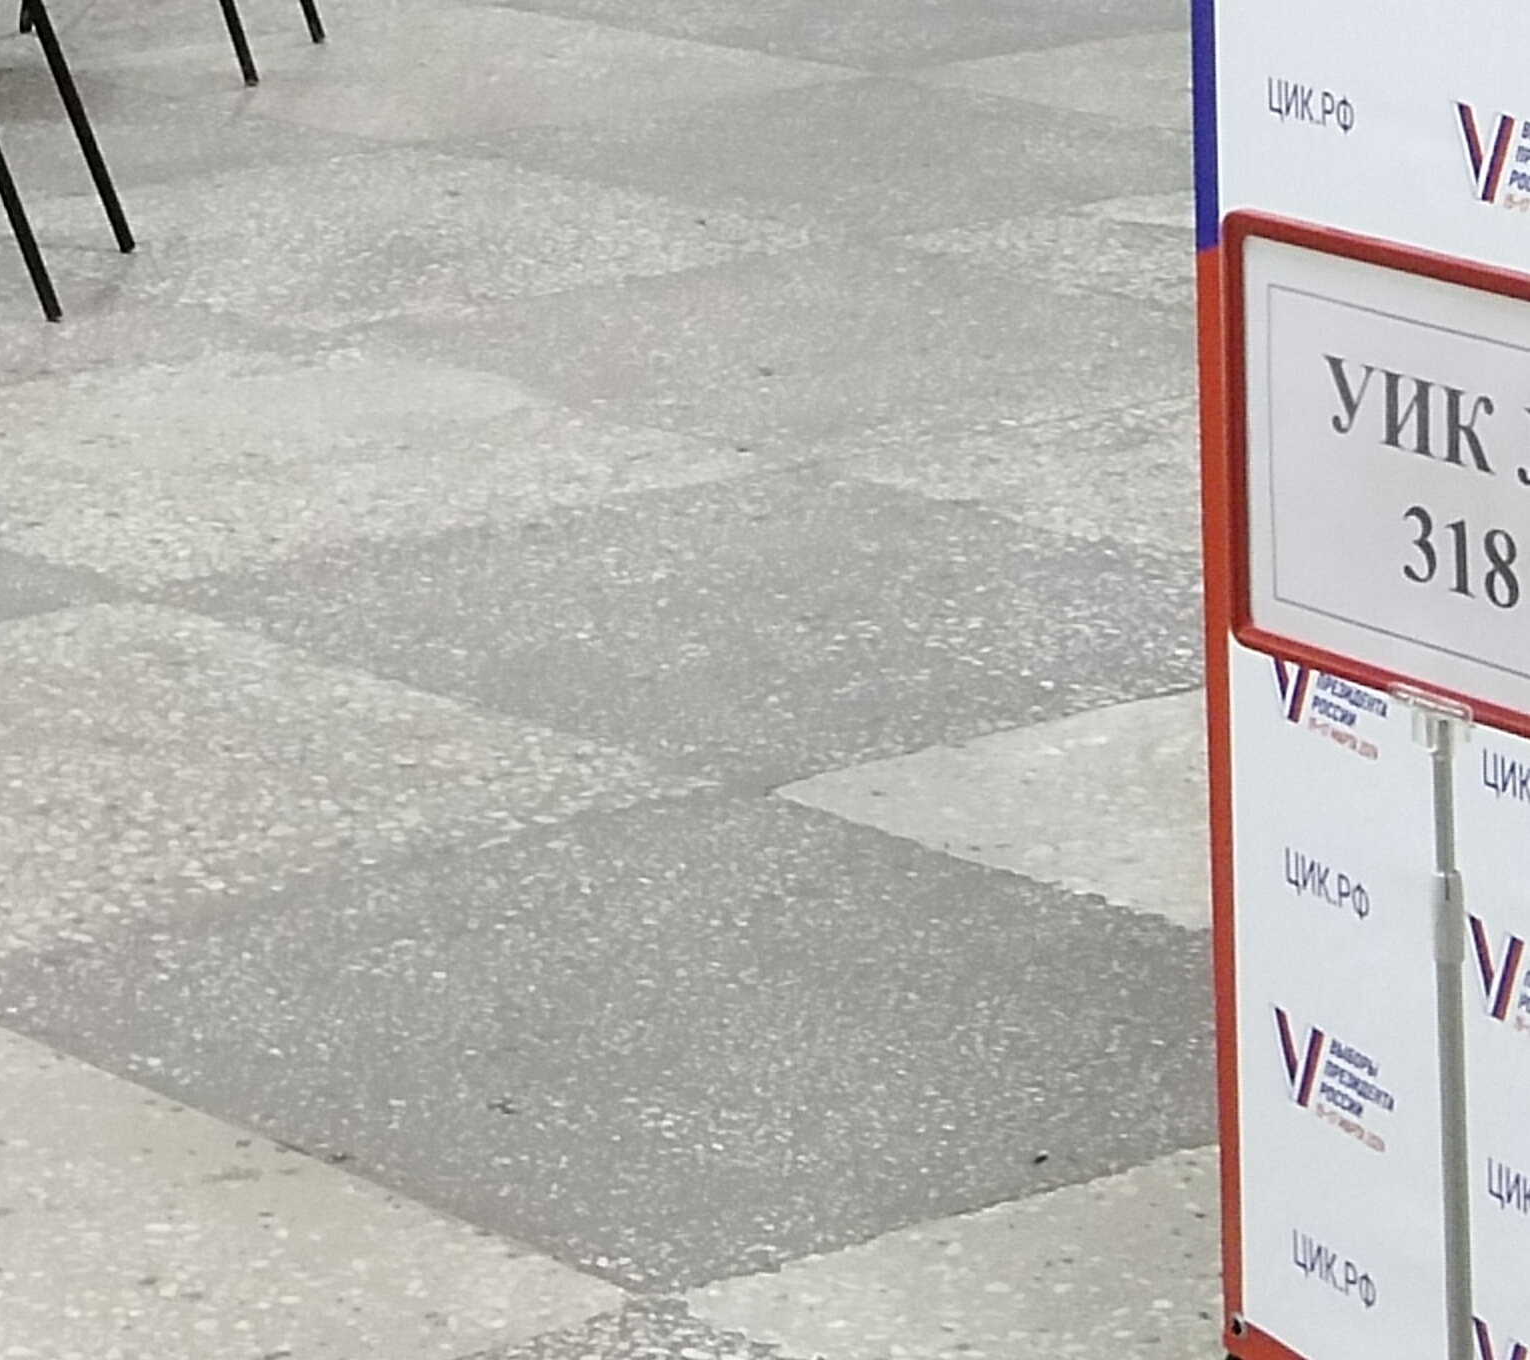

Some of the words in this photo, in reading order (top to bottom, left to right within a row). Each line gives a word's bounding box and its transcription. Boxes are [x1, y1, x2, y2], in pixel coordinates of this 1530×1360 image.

[1268, 77, 1355, 136] ЦИК.РФ
[1323, 353, 1496, 475] УИК
[1403, 505, 1519, 609] 318
[1285, 846, 1370, 920] ЦИК.РФ
[1293, 1227, 1377, 1310] ЦИК.РФ
